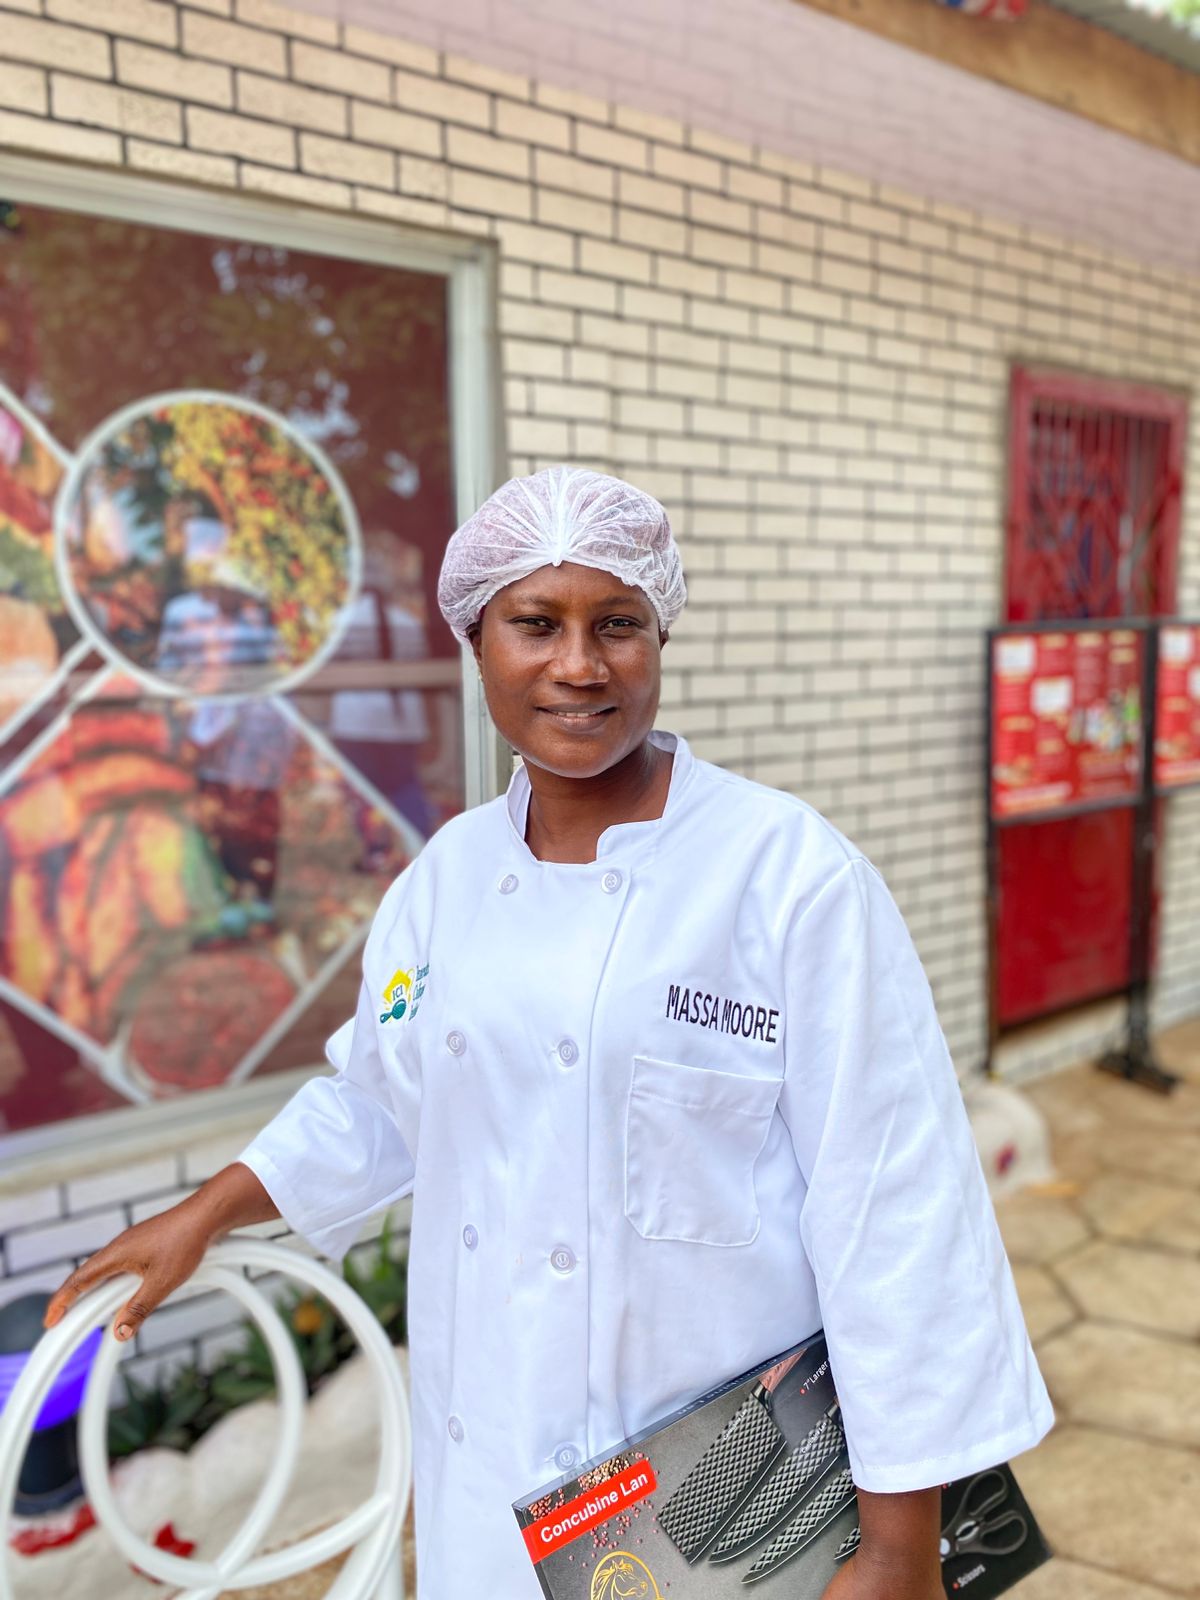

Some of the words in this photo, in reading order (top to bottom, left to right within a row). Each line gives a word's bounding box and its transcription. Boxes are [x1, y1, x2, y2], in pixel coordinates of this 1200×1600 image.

[666, 984, 720, 1031] MASSA
[720, 998, 779, 1043] MOORE
[540, 1490, 619, 1543] Concubine
[619, 1473, 649, 1496] Lan
